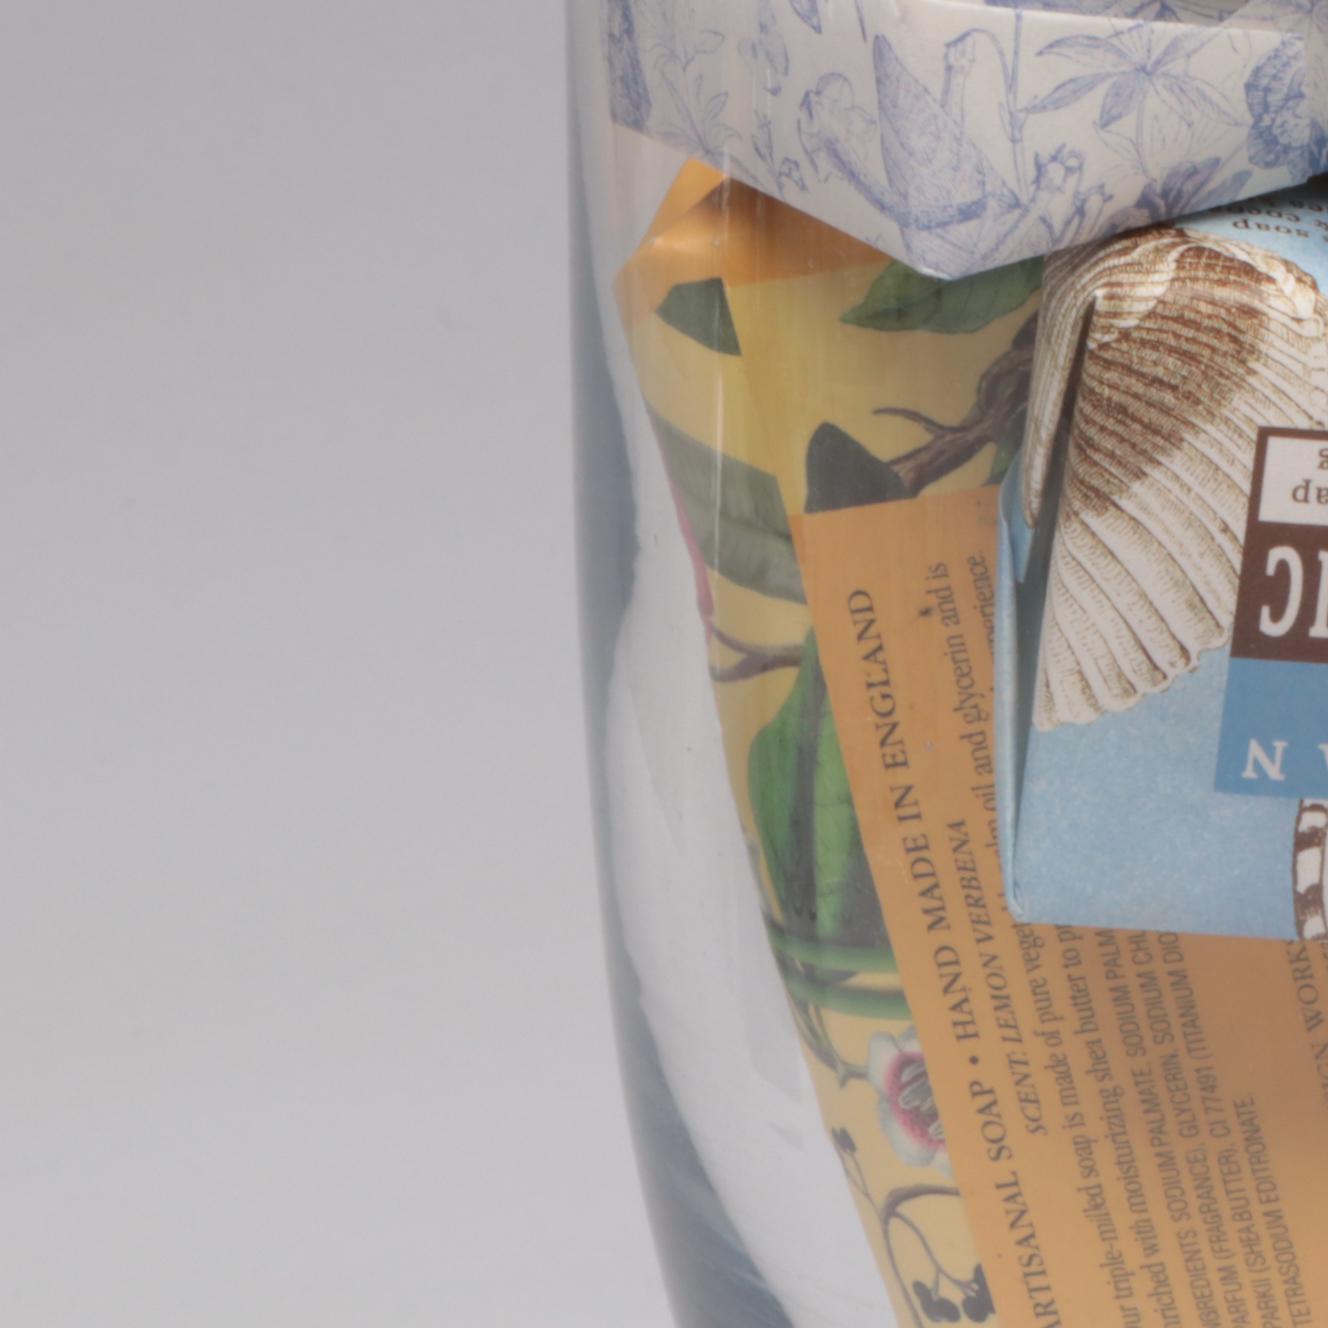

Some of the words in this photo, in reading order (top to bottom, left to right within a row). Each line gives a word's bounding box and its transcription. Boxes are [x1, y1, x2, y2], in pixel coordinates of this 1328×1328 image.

[1232, 218, 1310, 240] soap
[924, 561, 951, 582] is
[924, 583, 962, 628] and
[847, 588, 910, 772] ENGLAND
[942, 632, 991, 726] glycerin
[958, 728, 995, 777] and
[889, 784, 923, 824] IN
[901, 833, 952, 934] MADE
[945, 818, 996, 946] VERBENA
[1061, 946, 1083, 970] to
[933, 944, 981, 1043] HAND
[978, 951, 1024, 1045] LEMON
[1028, 976, 1066, 1025] pure
[1065, 973, 1100, 1037] butter
[1107, 983, 1148, 1058] SODIUM
[1135, 969, 1176, 1046] SODIUM
[1032, 1028, 1064, 1049] of
[1083, 1037, 1114, 1084] shea
[1042, 1052, 1081, 1108] made
[968, 1079, 1014, 1163] SOAP
[1061, 1110, 1087, 1130] is
[1098, 1084, 1150, 1215] moisturizing
[1071, 1133, 1101, 1181] soap
[1153, 1149, 1193, 1224] SODIUM
[993, 1170, 1063, 1328] RTISANAL
[1075, 1181, 1137, 1301] triple-milled
[1128, 1216, 1162, 1260] with
